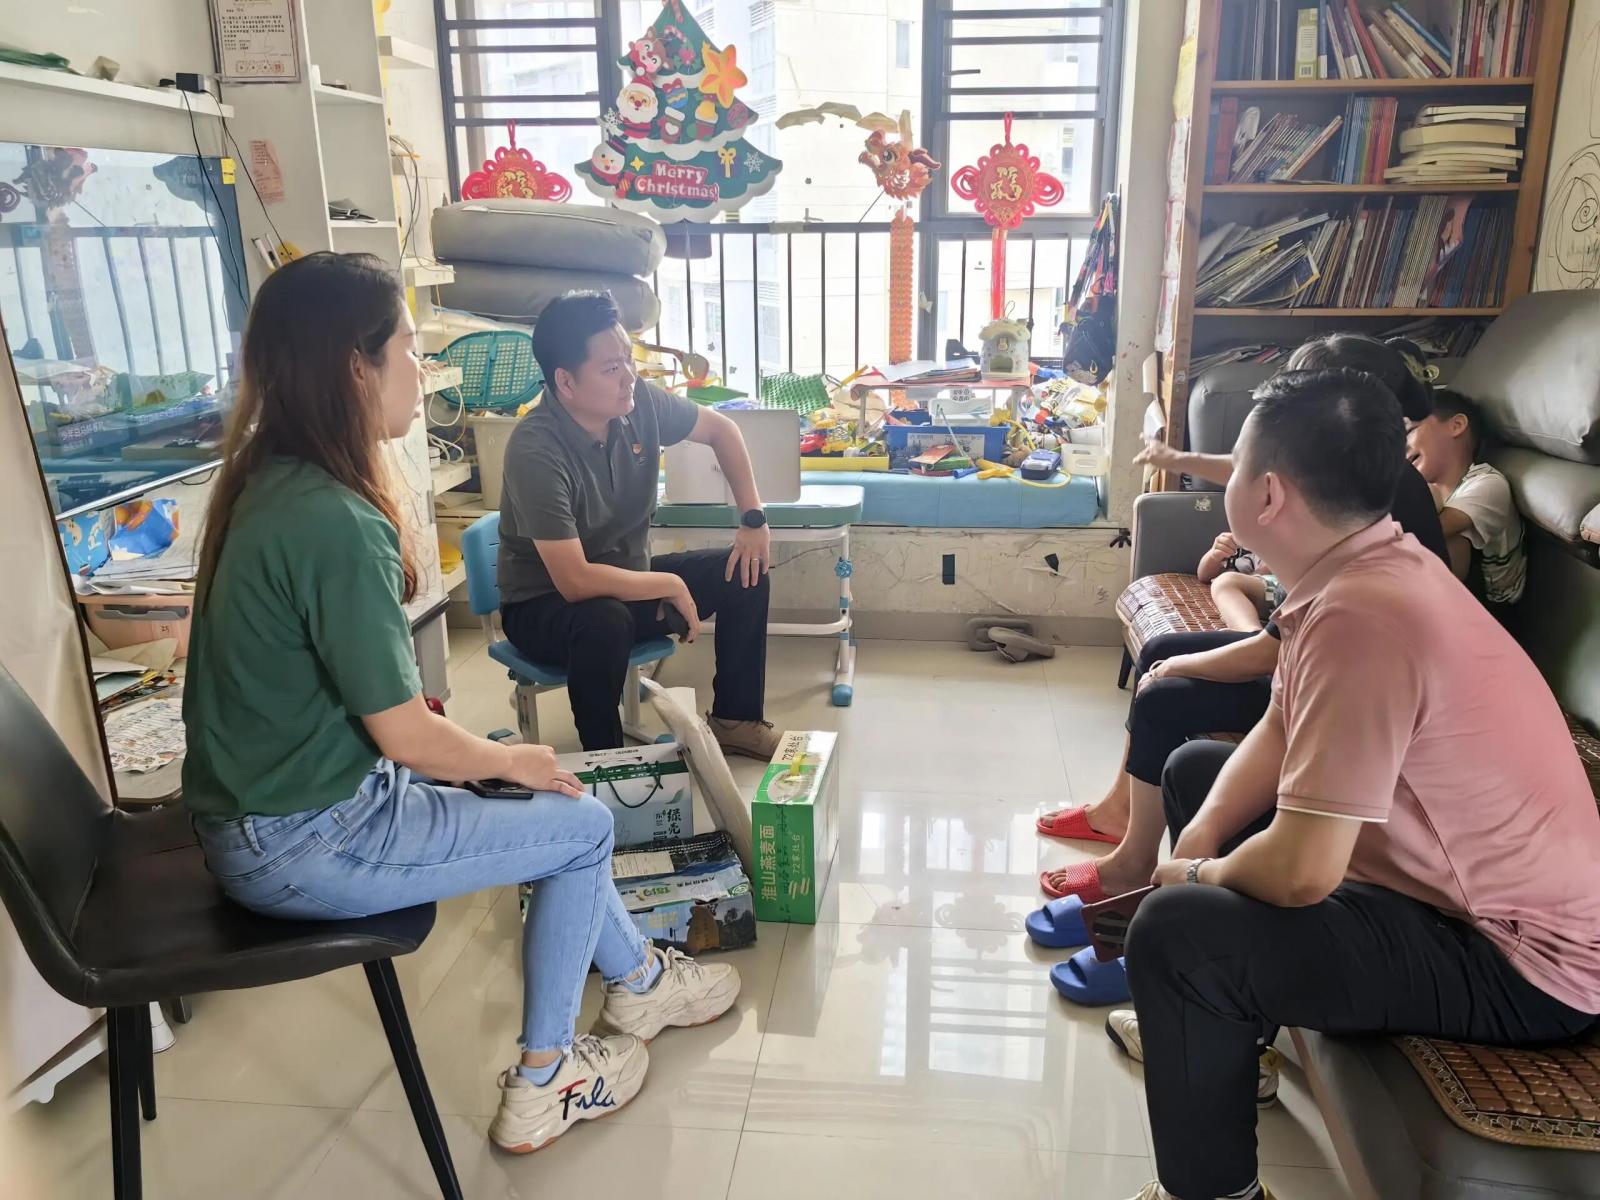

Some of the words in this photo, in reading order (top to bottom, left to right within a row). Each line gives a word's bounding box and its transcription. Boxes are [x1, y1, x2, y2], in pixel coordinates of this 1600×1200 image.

[655, 163, 705, 184] Merry
[759, 824, 777, 901] 淮山燕麦面
[557, 1076, 616, 1121] Fila
